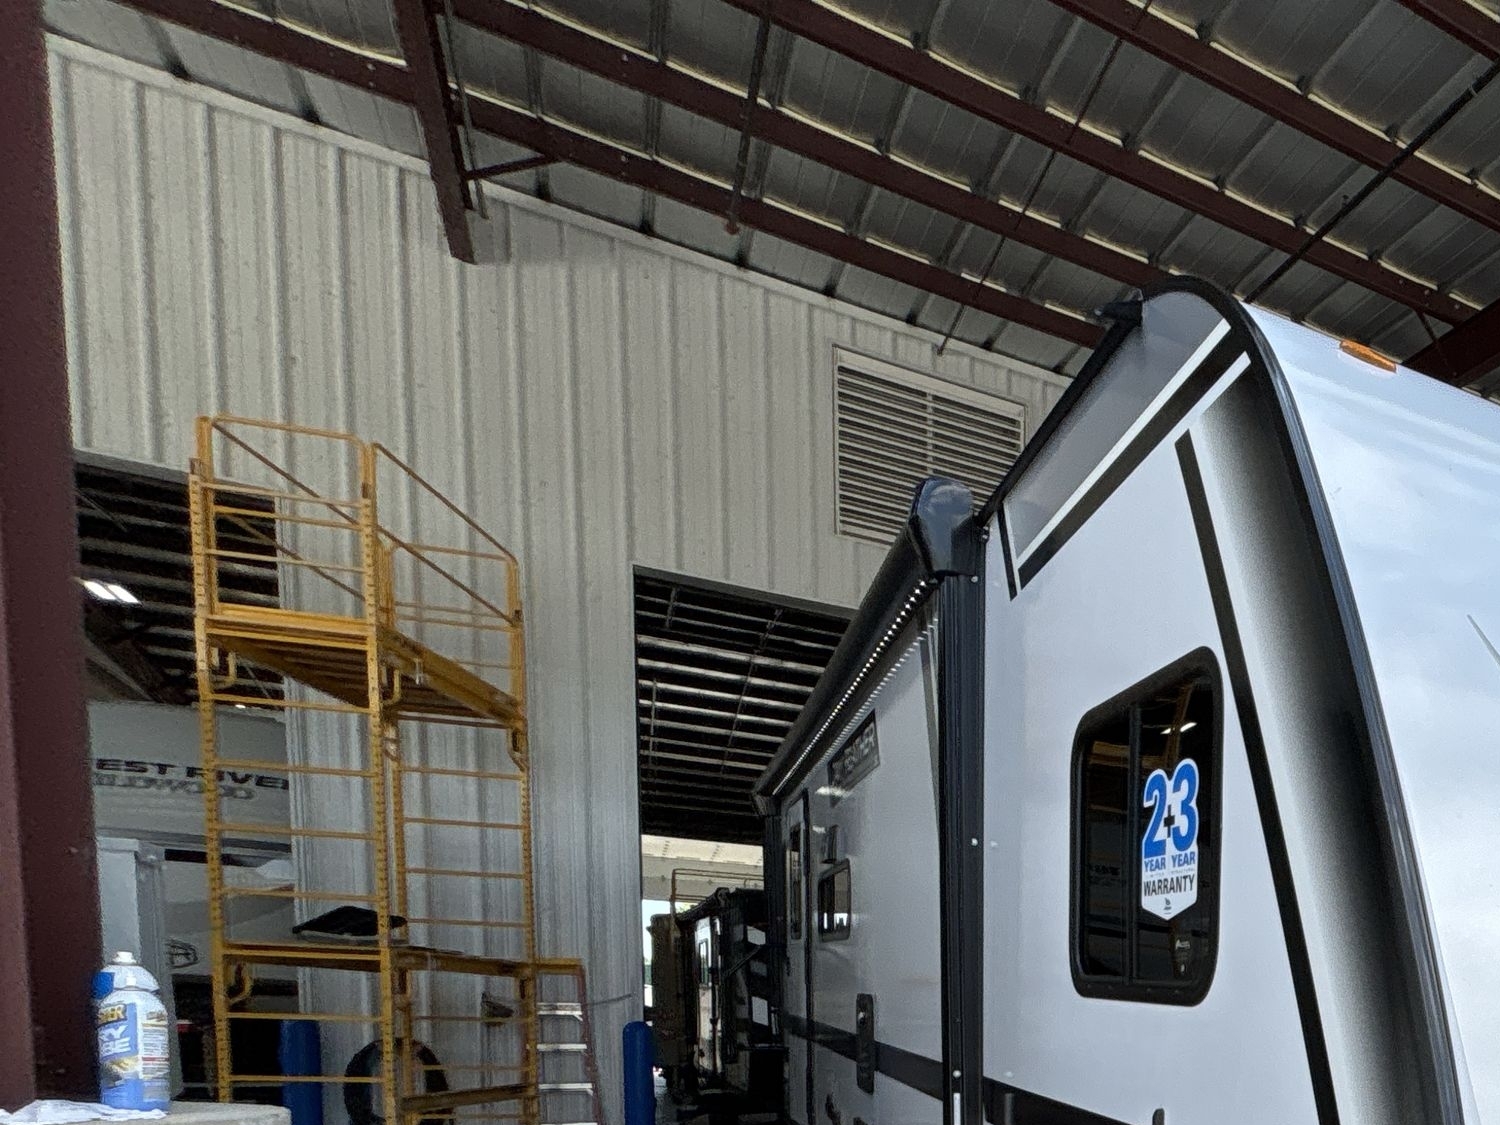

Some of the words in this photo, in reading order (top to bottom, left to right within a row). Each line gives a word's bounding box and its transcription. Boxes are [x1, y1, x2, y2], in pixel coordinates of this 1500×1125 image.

[1144, 857, 1166, 872] YEAR
[1171, 852, 1195, 868] YEAR
[1143, 873, 1195, 896] WARRANTY
